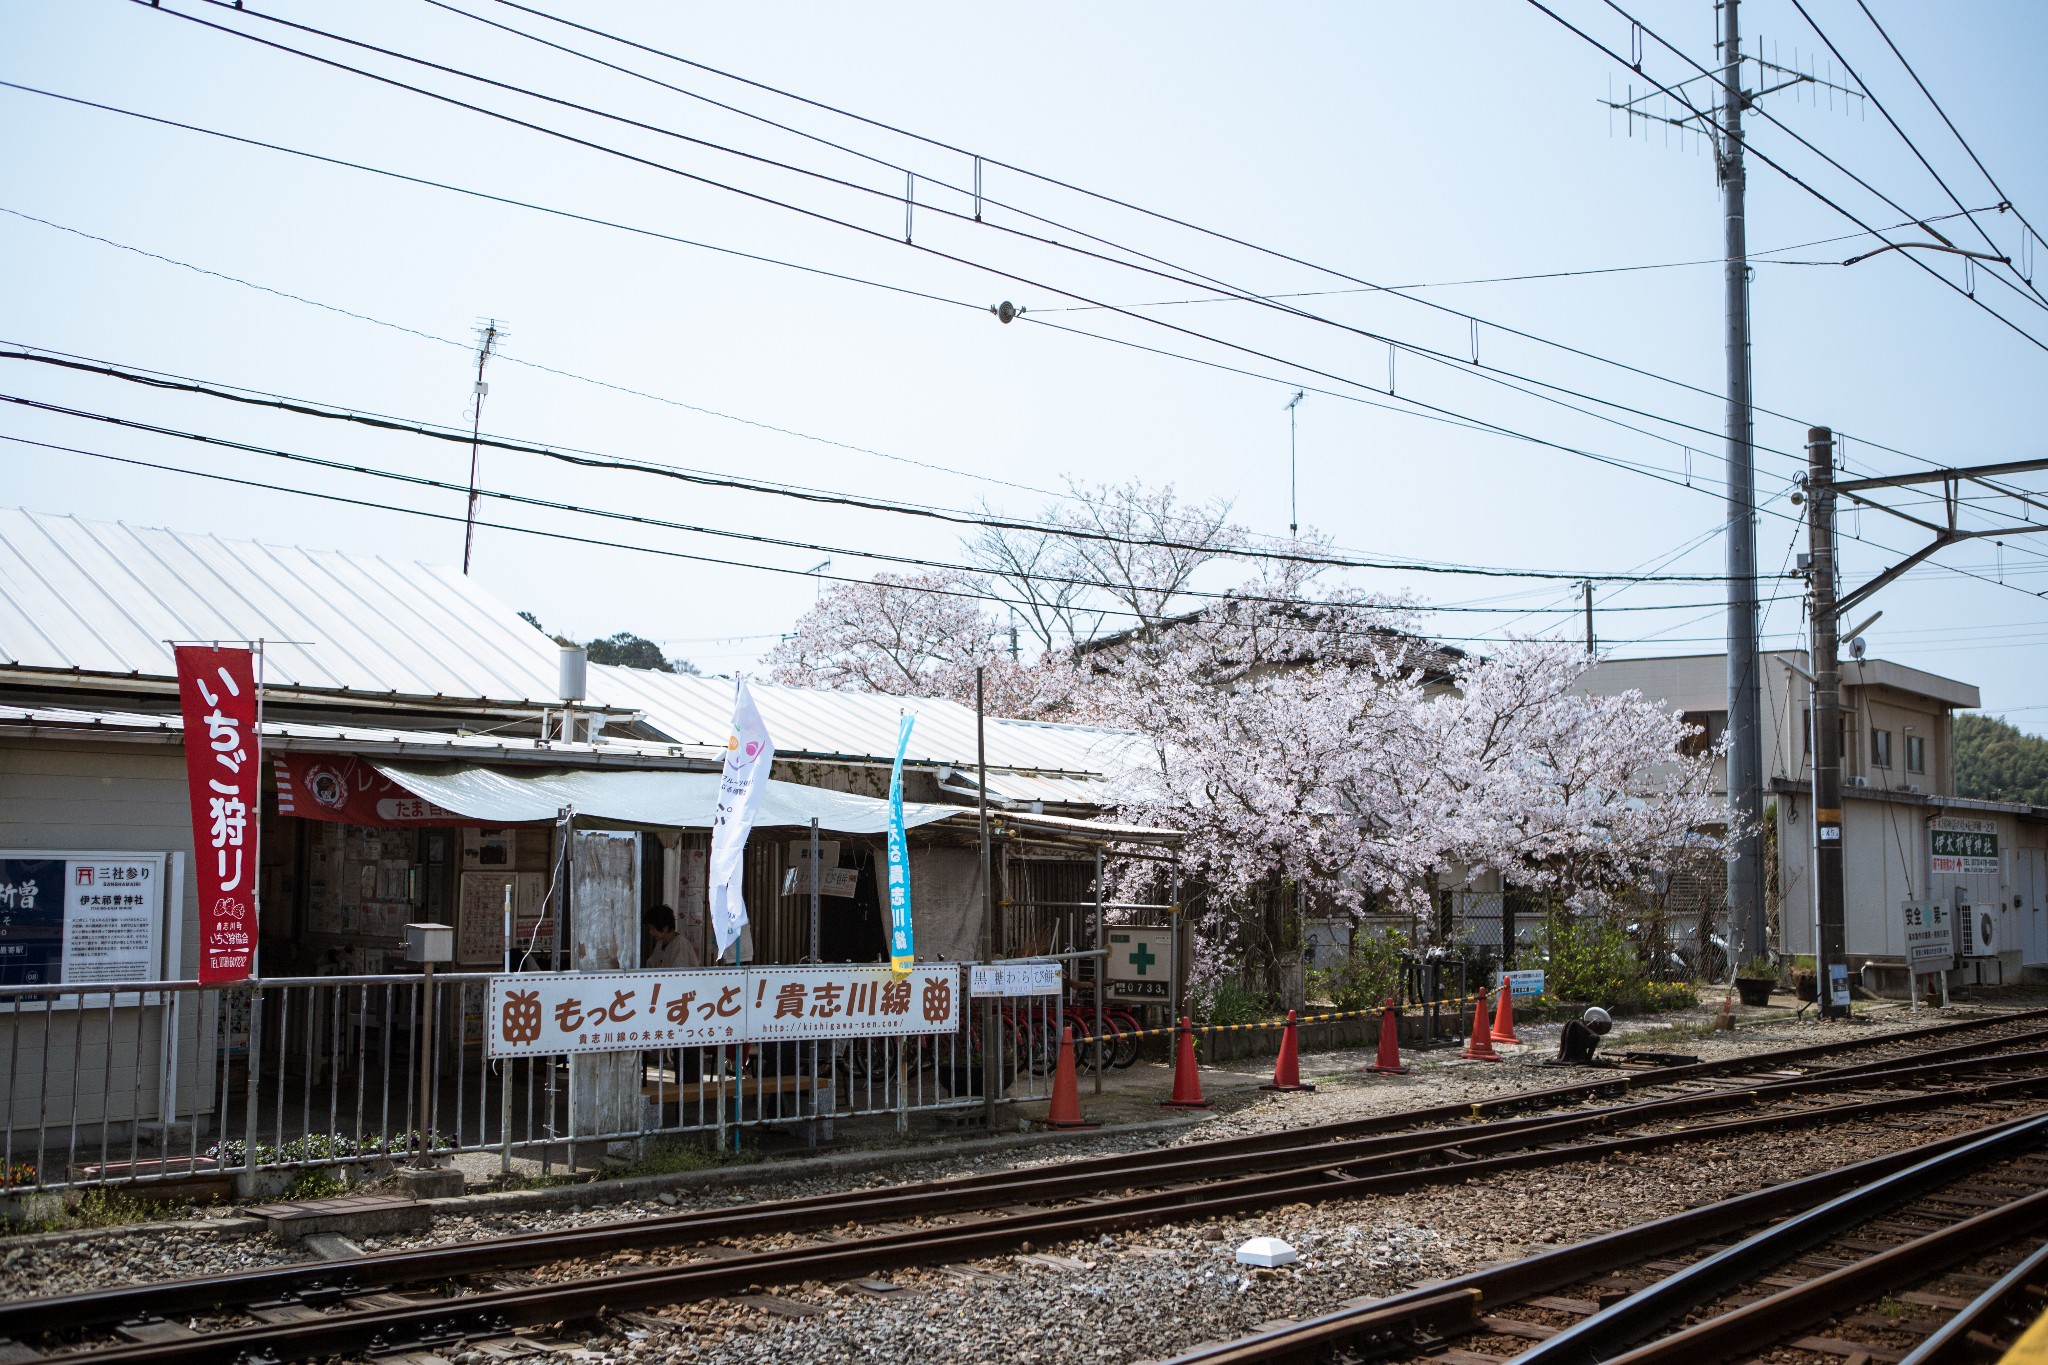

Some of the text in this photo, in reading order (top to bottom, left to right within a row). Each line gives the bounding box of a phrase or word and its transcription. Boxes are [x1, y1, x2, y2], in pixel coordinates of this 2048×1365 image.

[197, 666, 247, 892] いちご狩り
[98, 866, 150, 880] 三社参り
[1905, 905, 1948, 926] 安全 第一
[210, 957, 220, 969] TEL
[1127, 983, 1162, 993] 0733
[762, 1018, 904, 1033] http://kishigawa-sen.com/
